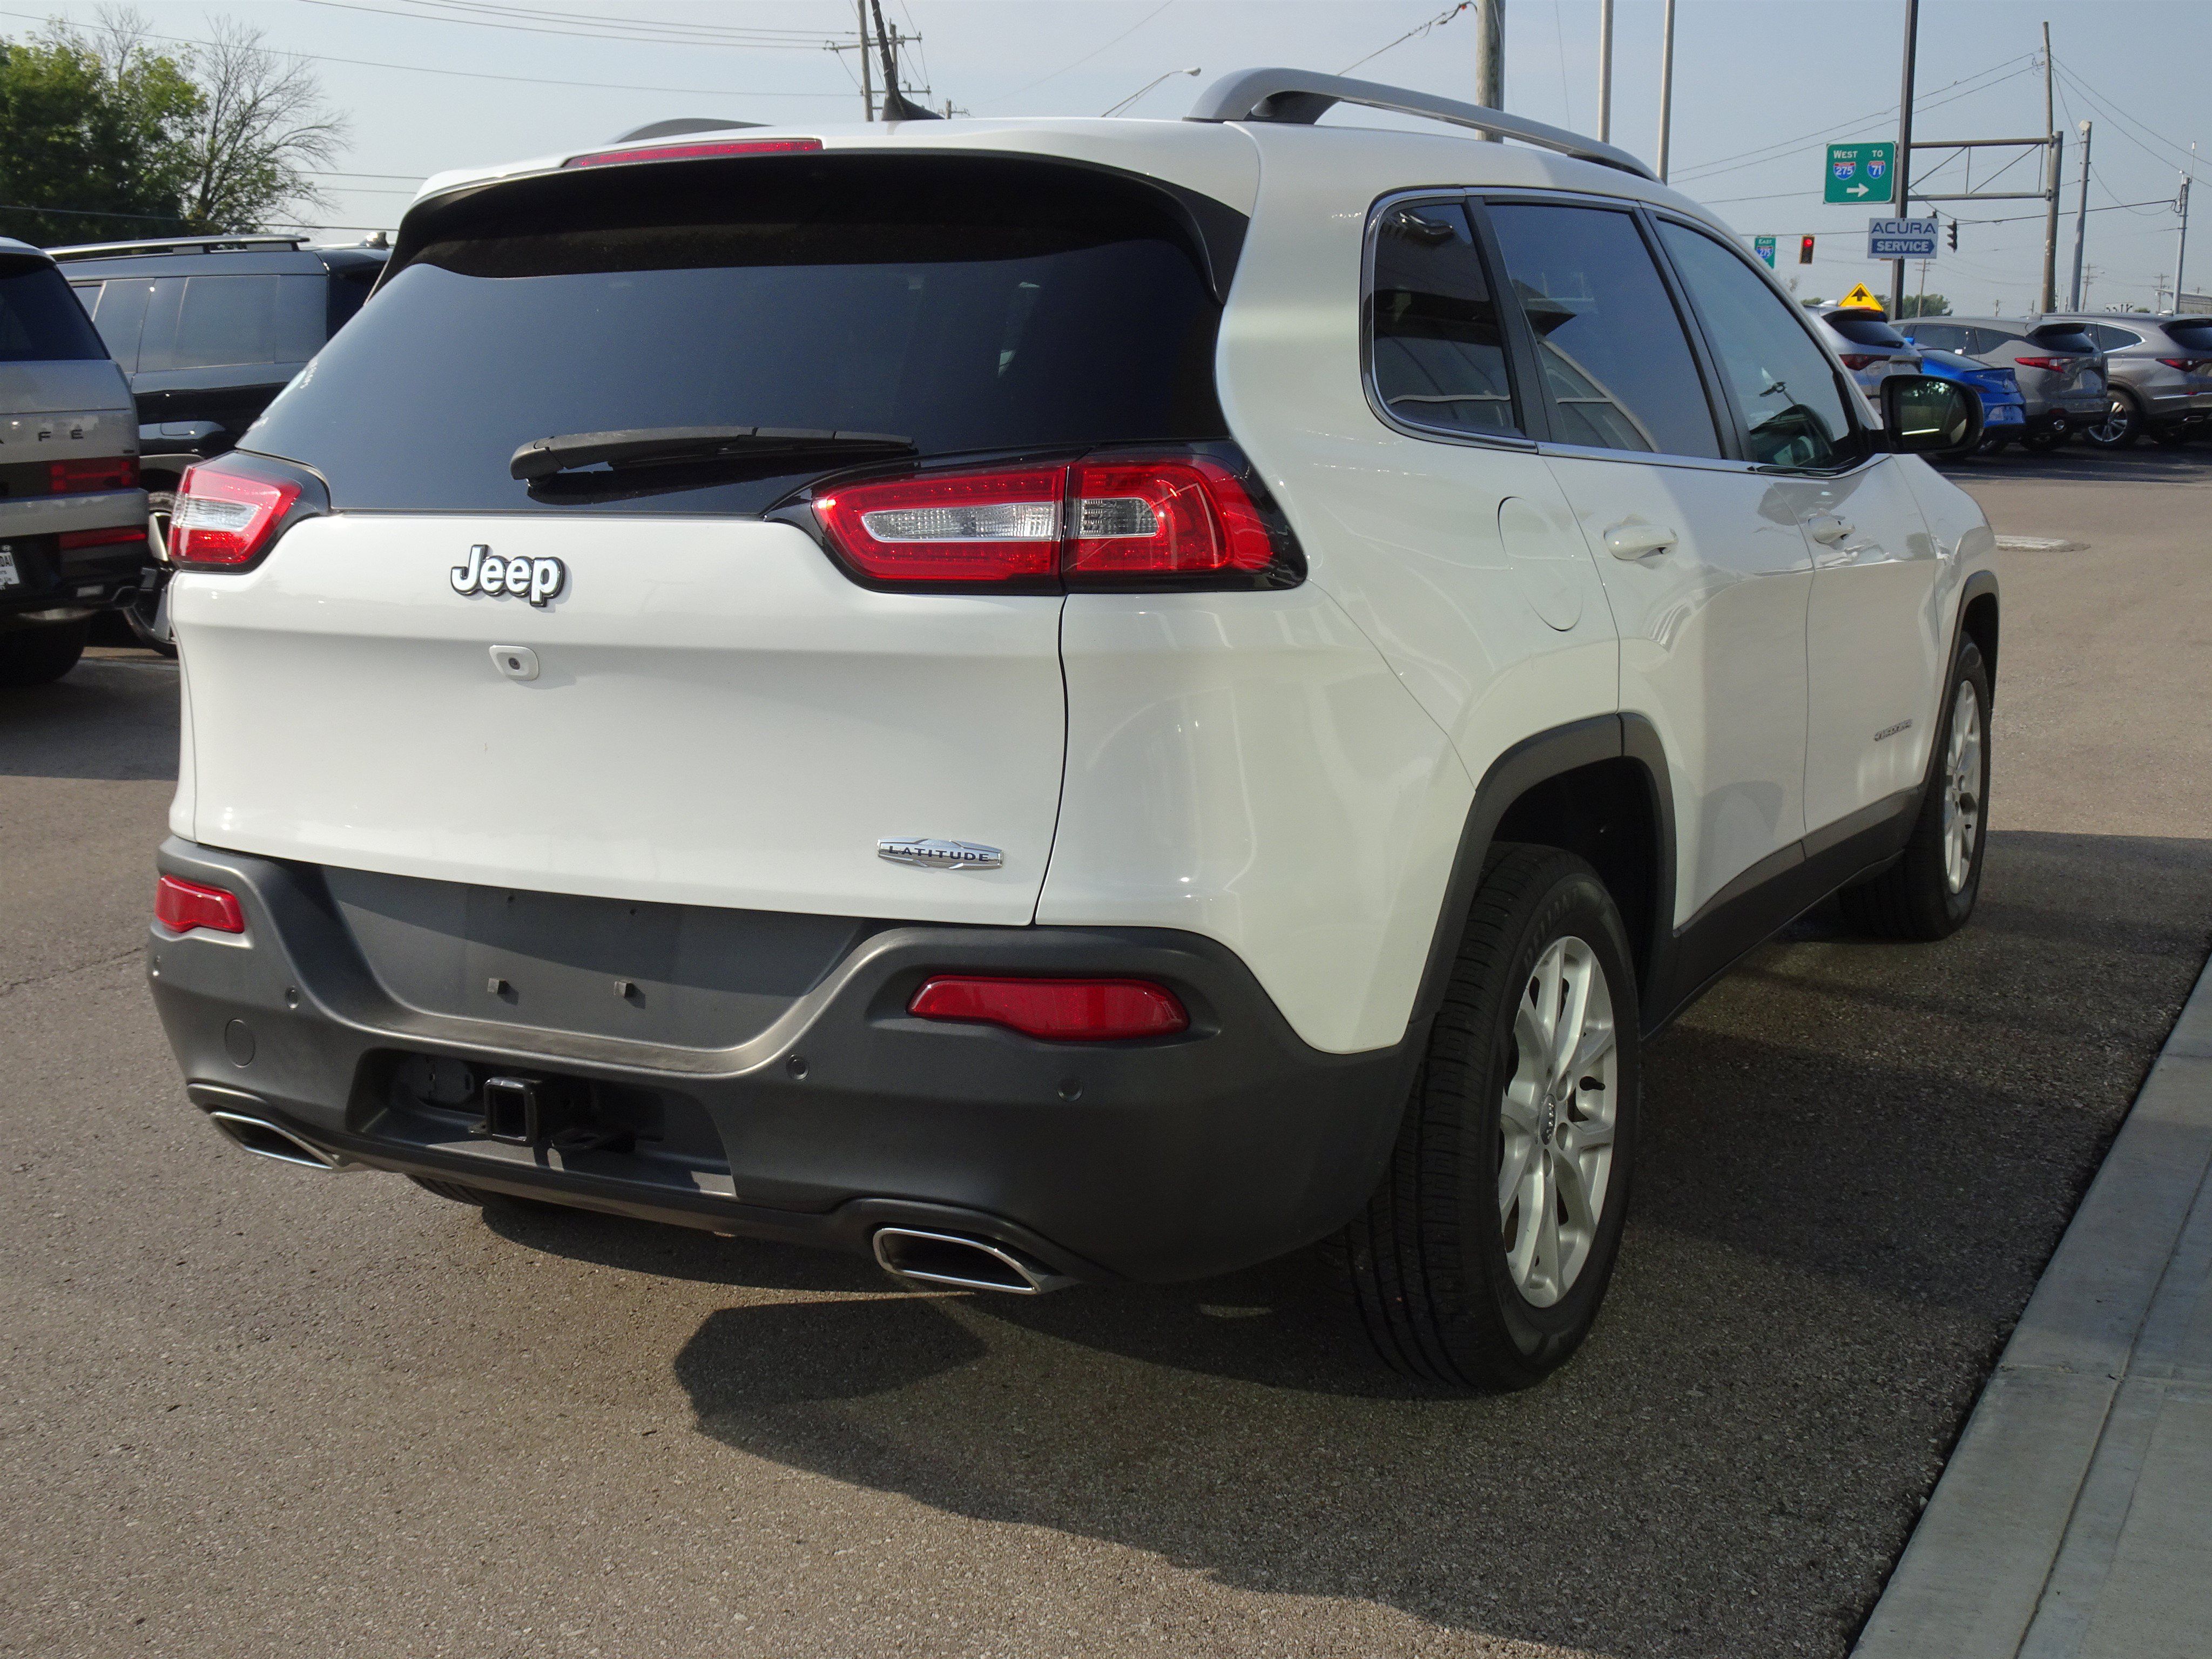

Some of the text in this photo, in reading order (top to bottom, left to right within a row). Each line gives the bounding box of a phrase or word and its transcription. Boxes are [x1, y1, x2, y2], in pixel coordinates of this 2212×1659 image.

[1833, 150, 1858, 159] WEST
[1836, 165, 1881, 176] 275 71
[1871, 222, 1936, 234] ACURA
[1876, 241, 1929, 252] SERVICE
[450, 544, 565, 607] Jeep
[889, 846, 989, 862] LATITUDE
